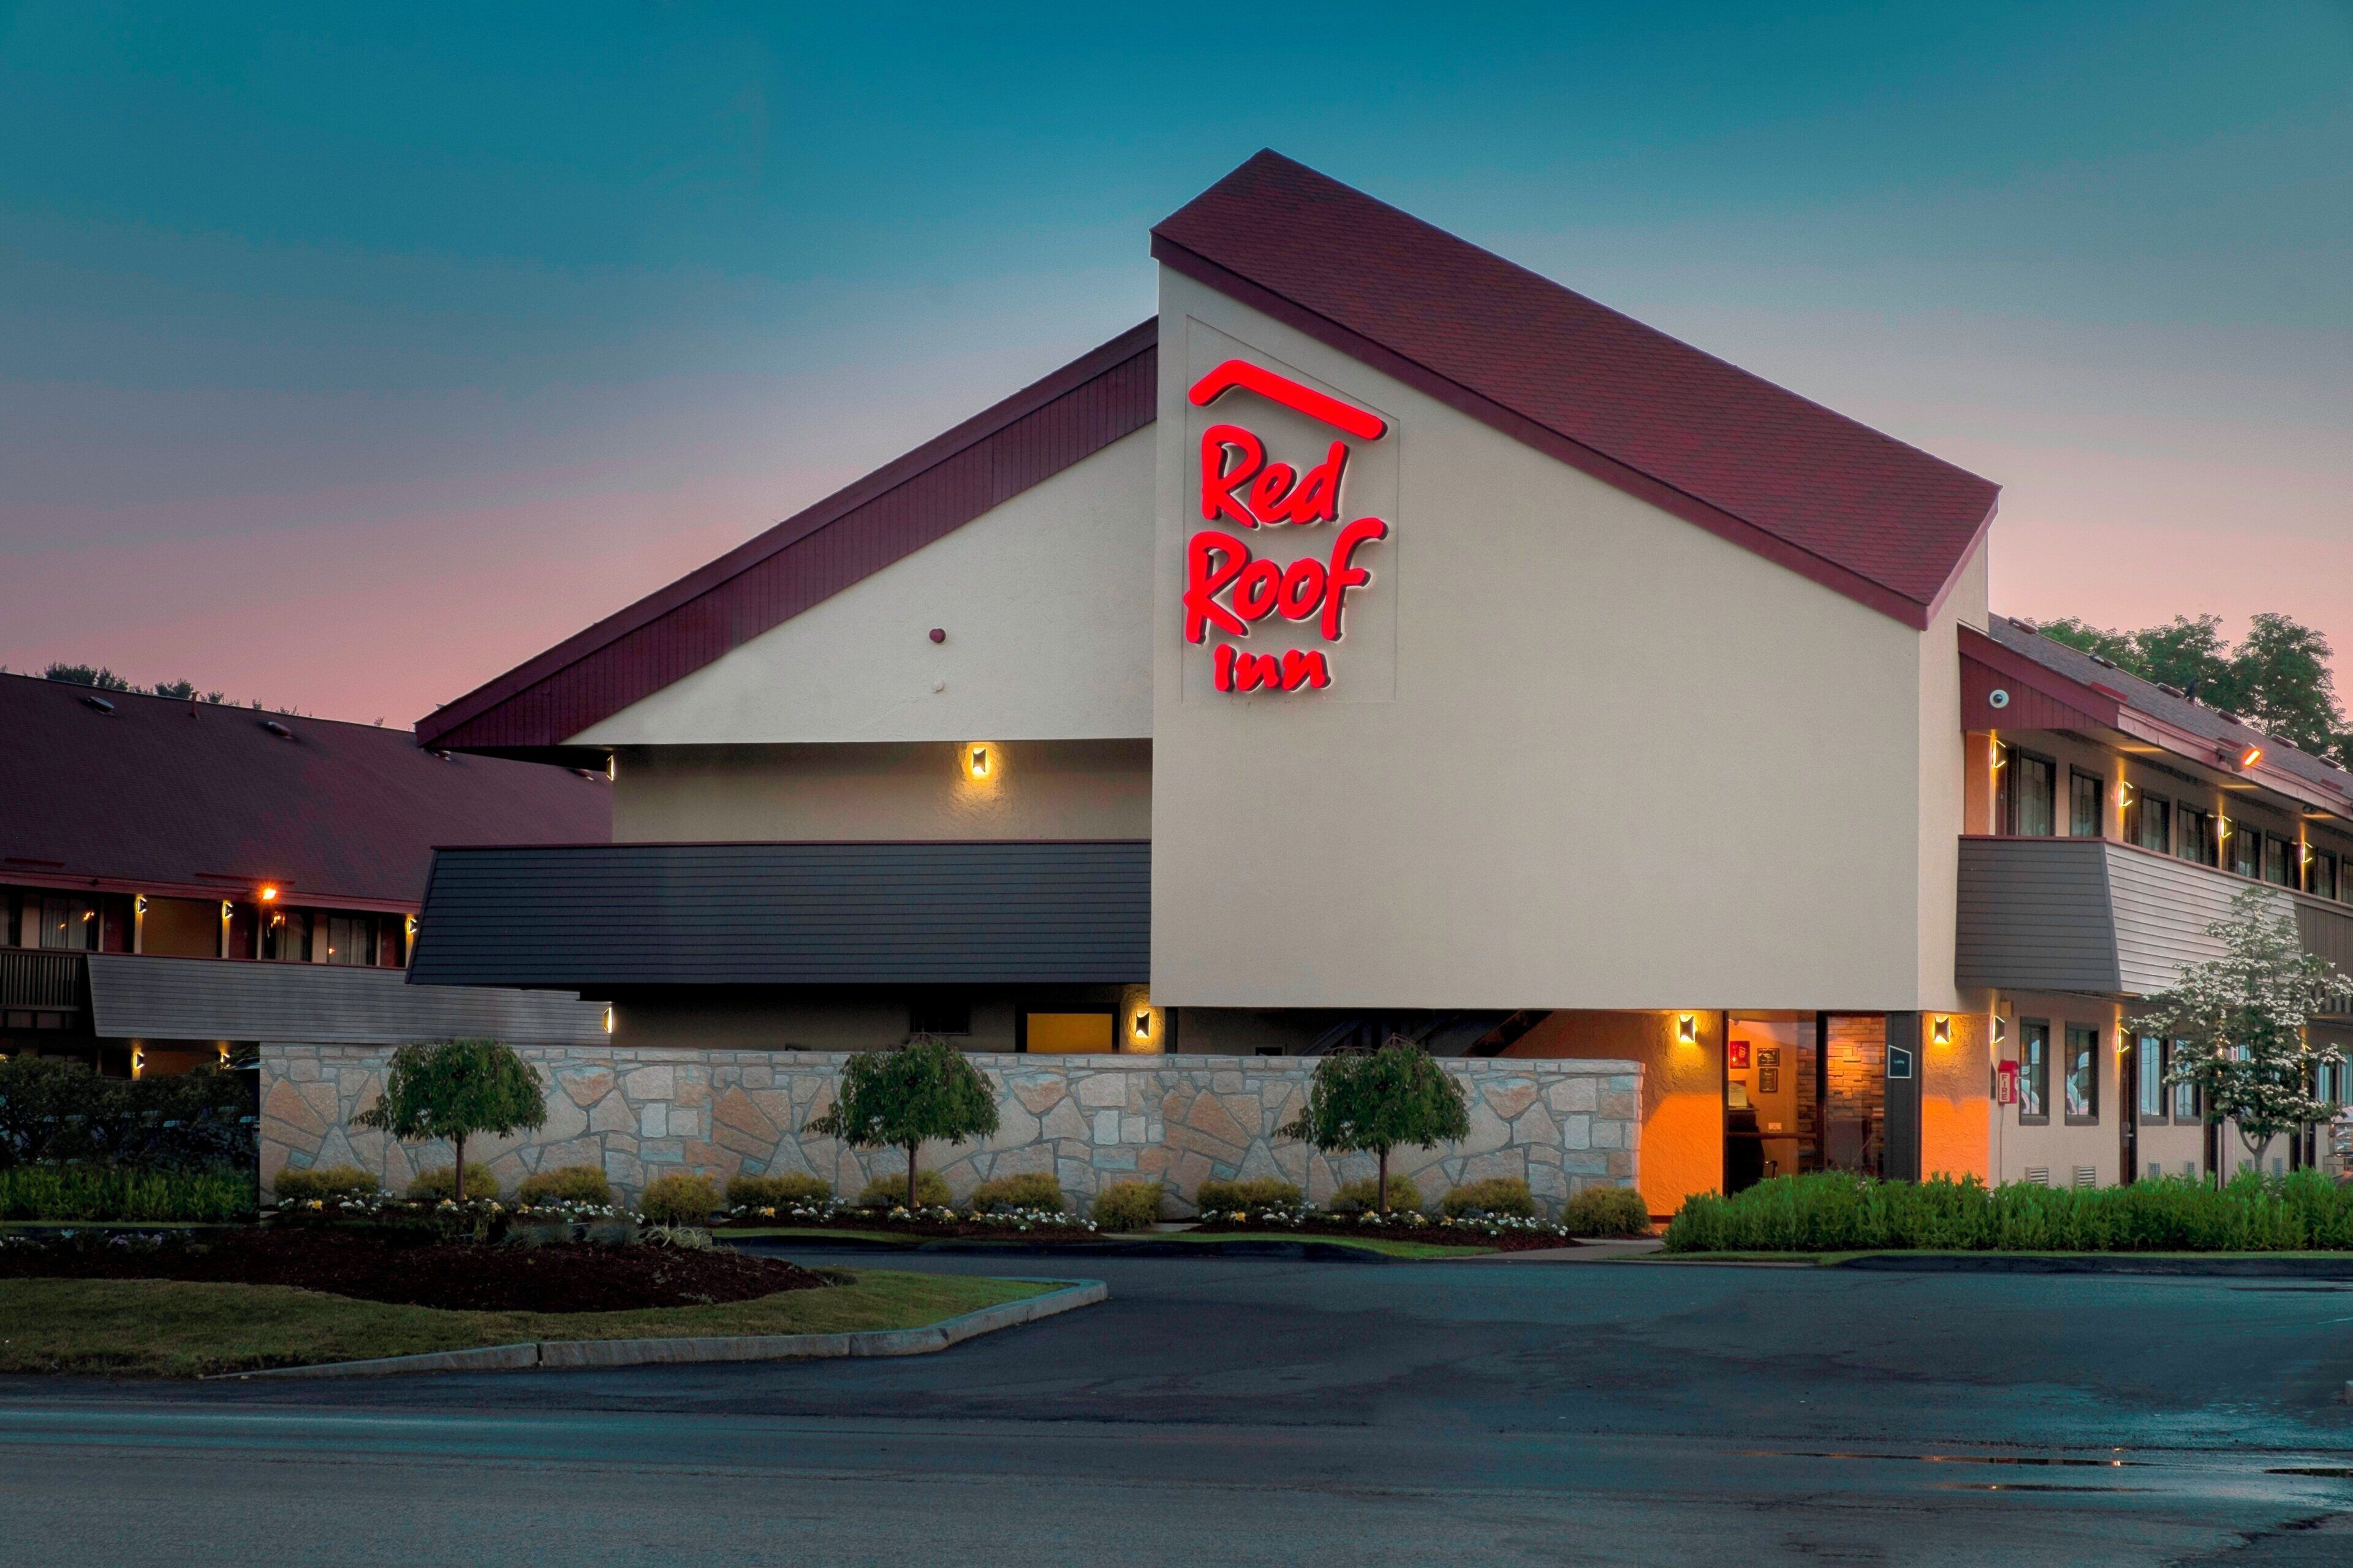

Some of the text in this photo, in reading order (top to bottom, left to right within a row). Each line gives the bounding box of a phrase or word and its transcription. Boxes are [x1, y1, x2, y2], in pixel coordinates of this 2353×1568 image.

[1201, 424, 1347, 528] Red
[1183, 517, 1387, 644] Roof
[1214, 643, 1329, 692] Inn
